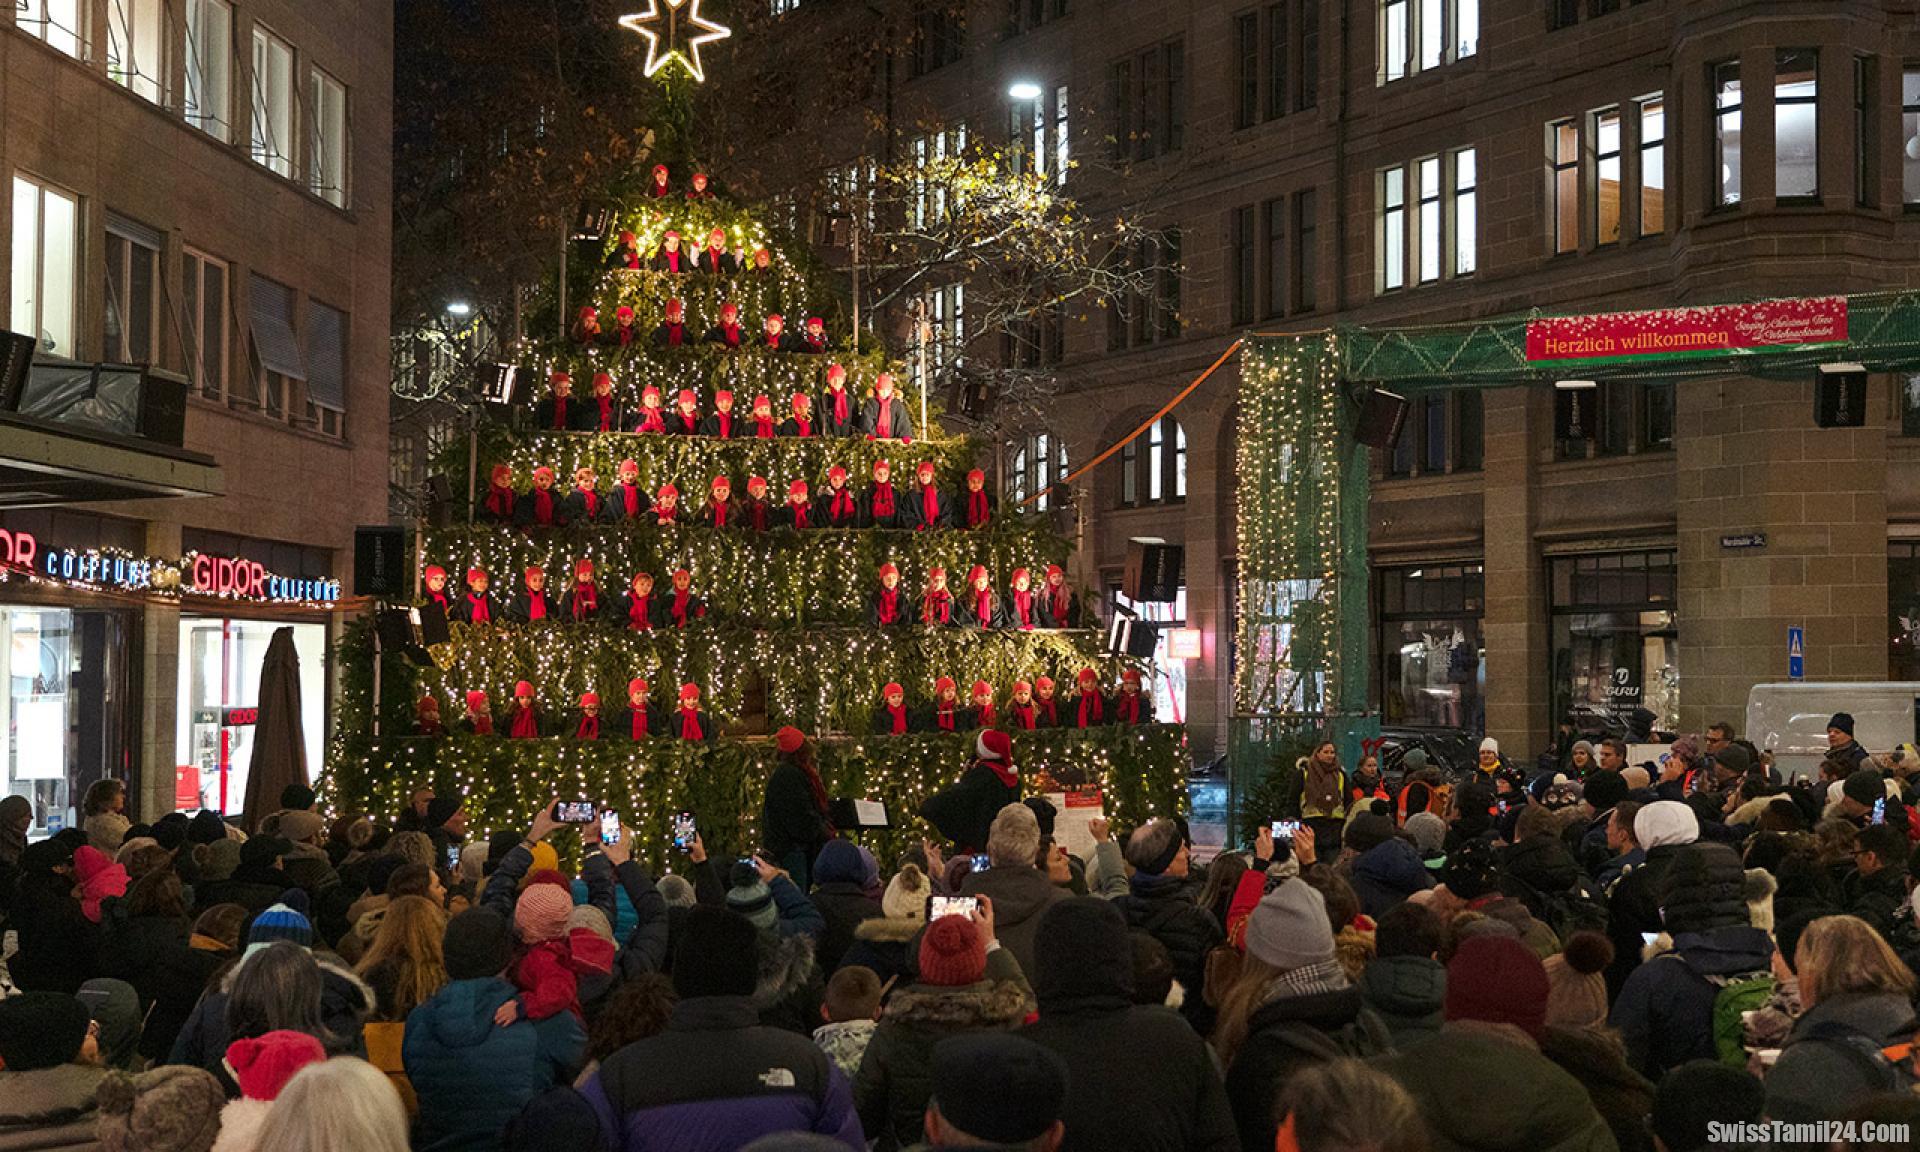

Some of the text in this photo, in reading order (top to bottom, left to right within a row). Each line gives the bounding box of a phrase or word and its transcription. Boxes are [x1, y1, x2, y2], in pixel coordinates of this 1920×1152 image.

[1545, 330, 1729, 354] Herzlich willkommen
[47, 551, 150, 585] COIFFURE
[193, 554, 340, 600] GIDOR COIFFURE
[1605, 686, 1640, 697] GURU
